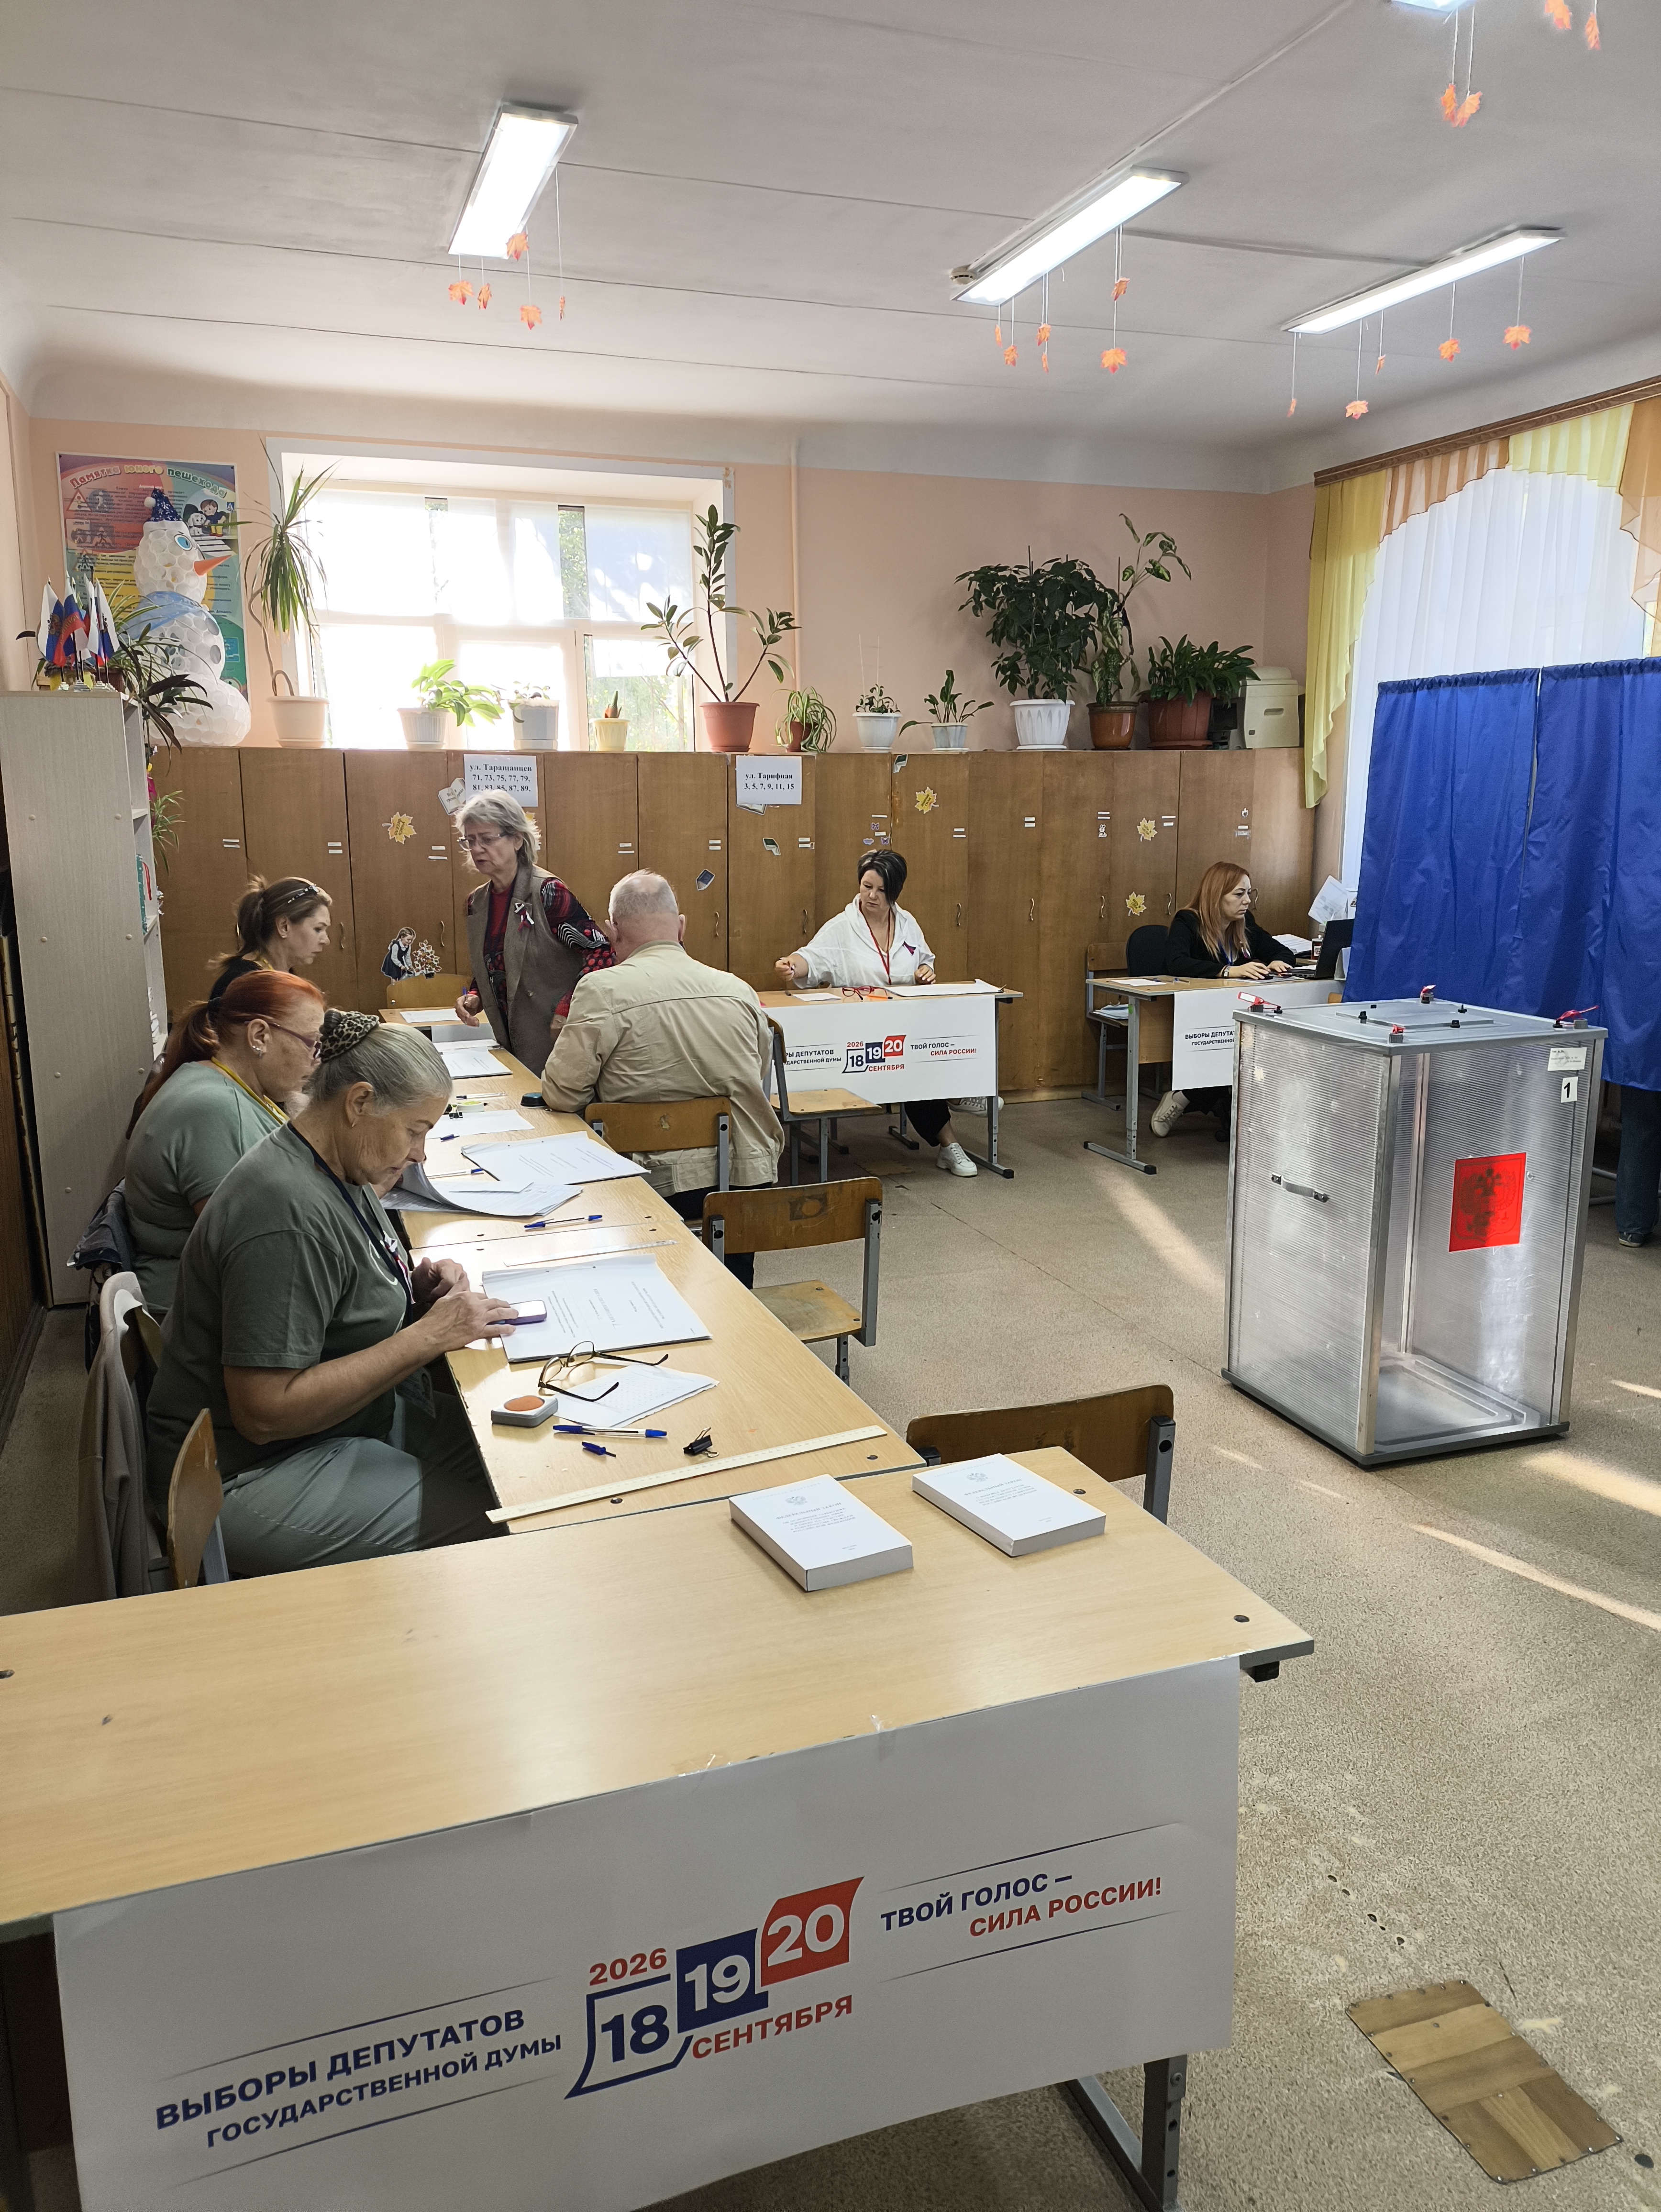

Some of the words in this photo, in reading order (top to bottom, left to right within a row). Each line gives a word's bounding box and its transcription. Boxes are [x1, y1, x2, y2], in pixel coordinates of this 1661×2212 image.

[68, 465, 121, 489] Памятка
[124, 464, 164, 475] юного
[167, 467, 227, 498] пешехода
[483, 763, 532, 772] Таращанцев
[757, 772, 793, 780] Тарифная
[785, 1057, 824, 1065] ДАРСТВЕННОЙ
[796, 1050, 834, 1058] ДЕПУТАТОВ
[849, 1055, 864, 1067] 18
[866, 1047, 882, 1060] 19
[885, 1039, 903, 1053] 20
[1564, 1082, 1571, 1098] 1
[881, 1892, 954, 1932] ТВОЙ
[960, 1872, 1049, 1912] ГОЛОС
[969, 1907, 1041, 1938] СИЛА
[1048, 1876, 1163, 1920] РОССИИ!
[588, 1947, 668, 1986] 2026
[600, 2003, 671, 2063] 18
[684, 1954, 752, 2010] 19
[766, 1902, 846, 1968] 20
[690, 1994, 853, 2059] СЕНТЯБРЯ
[154, 2061, 318, 2130] ВЫБОРЫ
[326, 2009, 525, 2080] ДЕПУТАТОВ
[207, 2049, 479, 2148] ГОСУДАРСТВЕННОЙ
[484, 2034, 563, 2072] ДУМЫ
